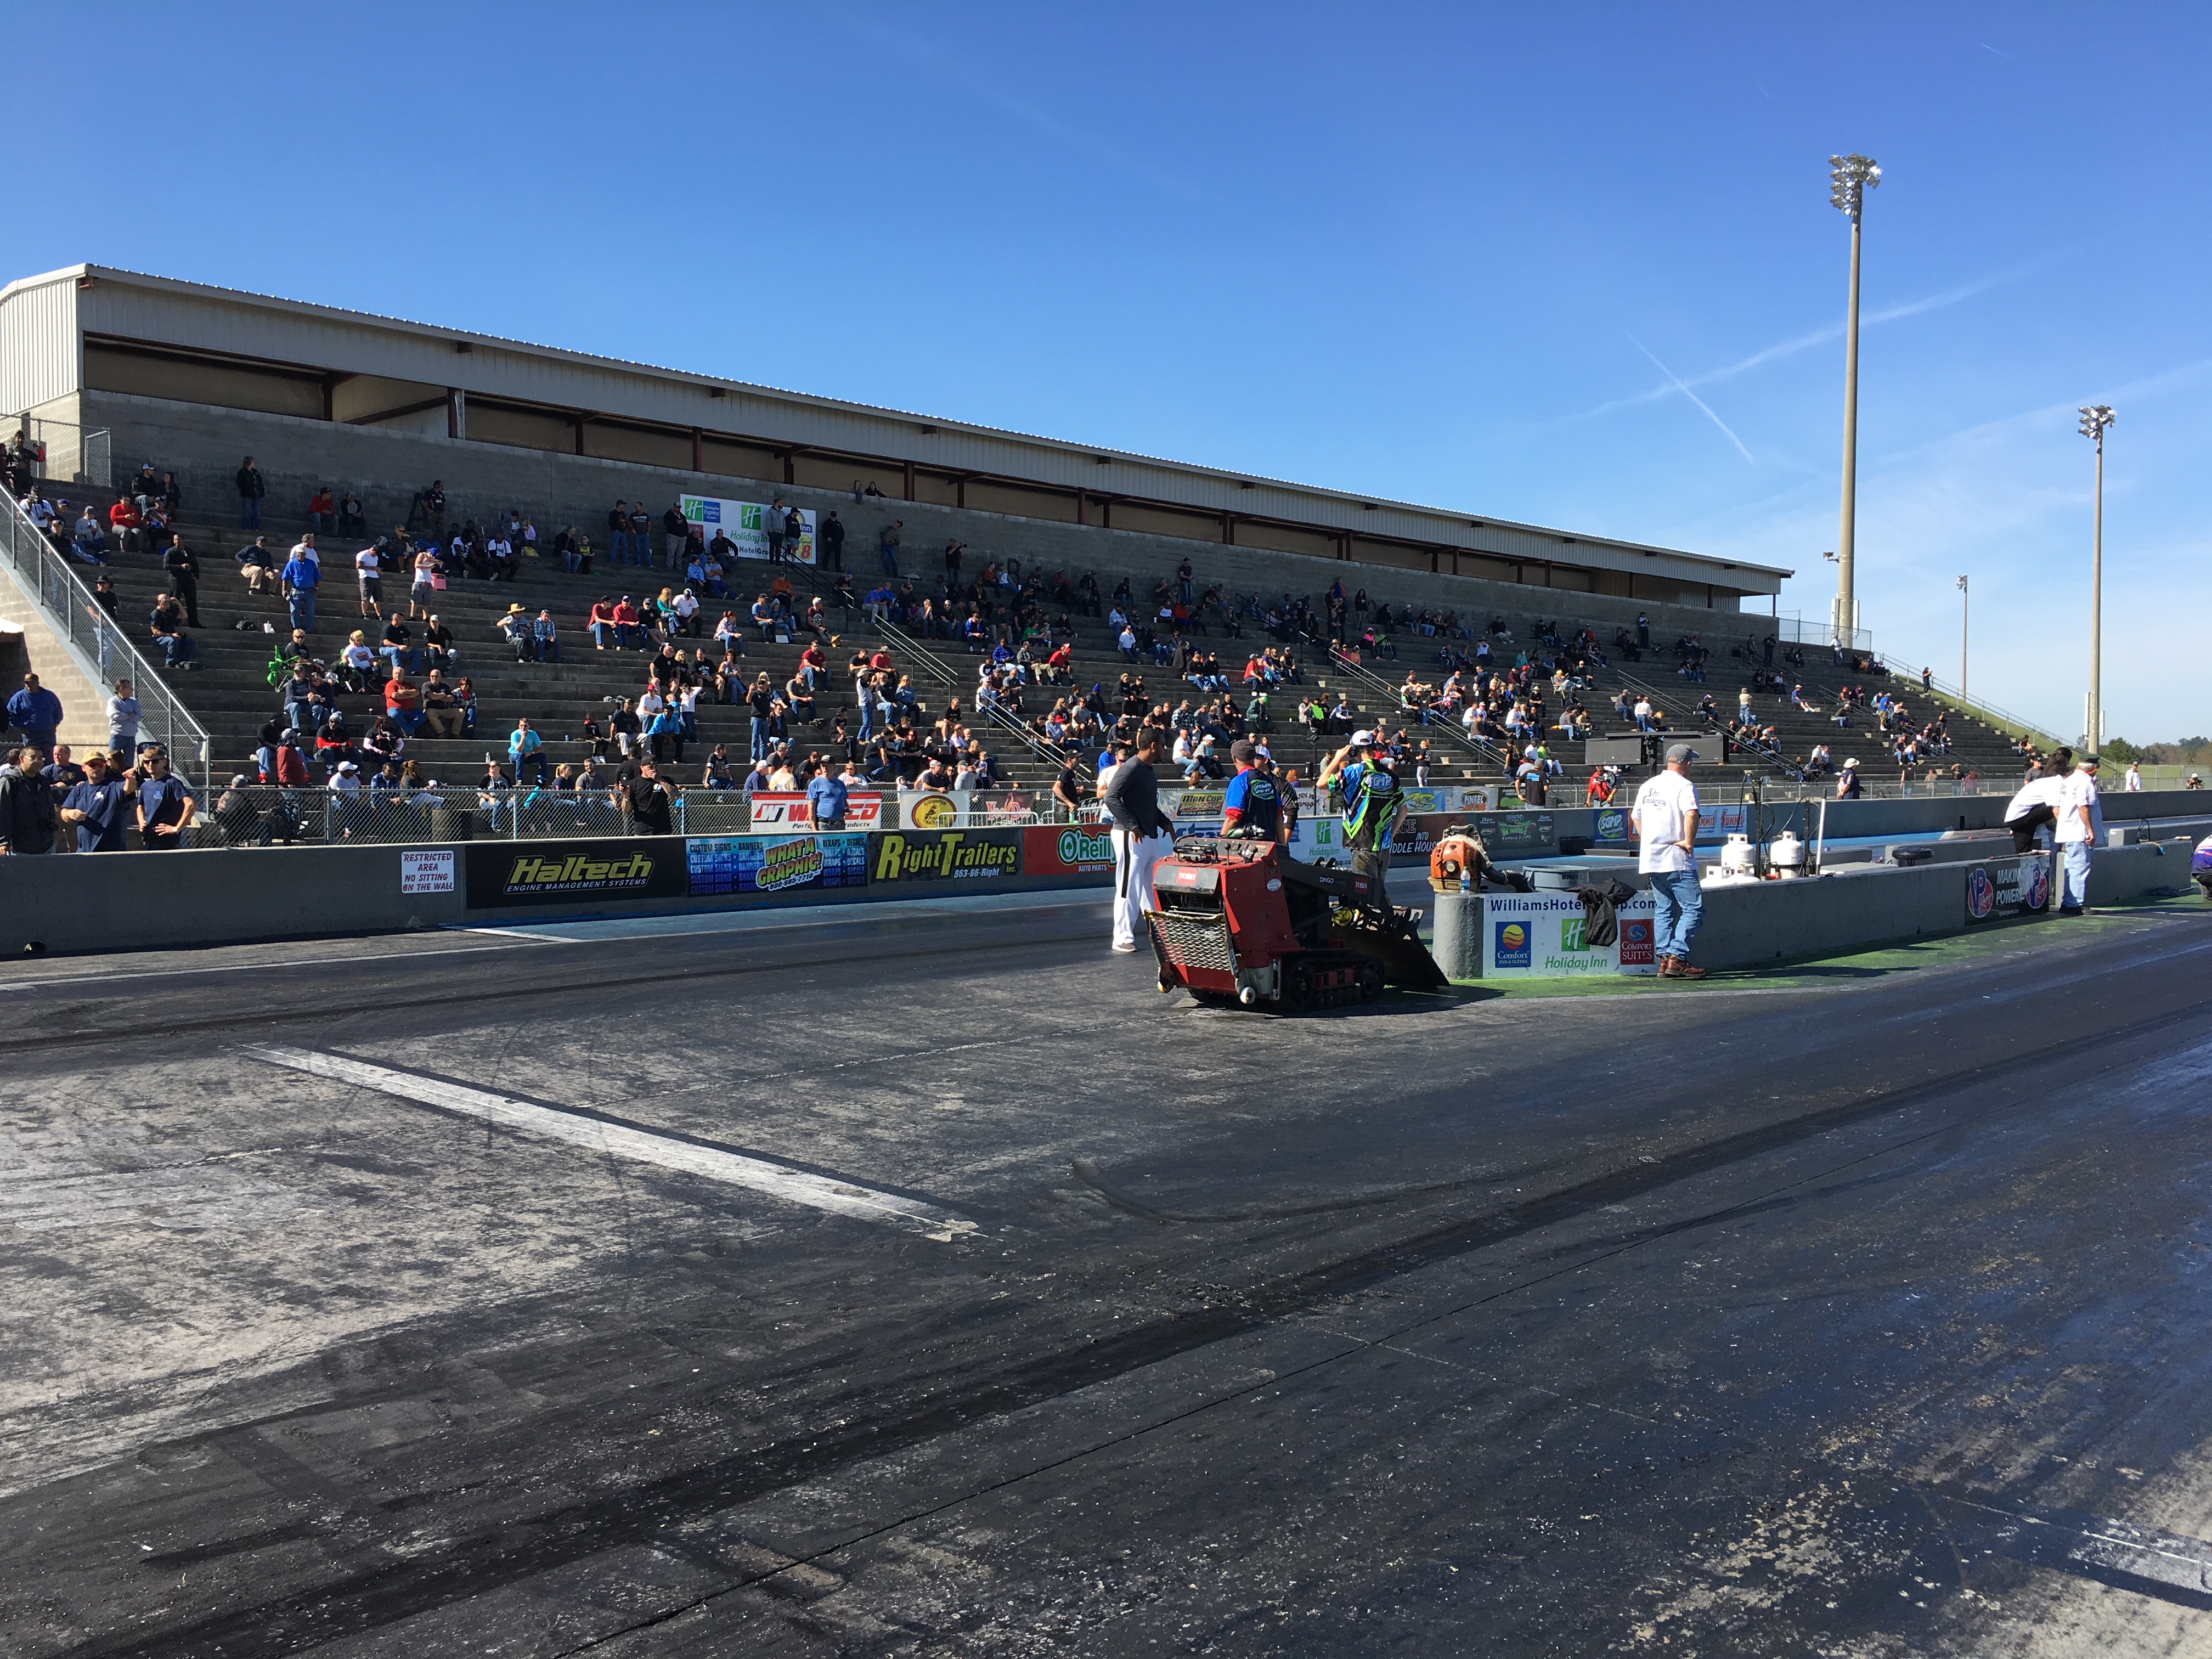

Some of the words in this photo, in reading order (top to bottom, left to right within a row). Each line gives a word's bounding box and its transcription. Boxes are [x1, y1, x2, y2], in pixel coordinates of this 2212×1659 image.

[730, 530, 760, 544] Holiday
[1464, 795, 1484, 804] PINGEL
[1601, 814, 1622, 829] SGMP
[1416, 832, 1429, 840] INTO
[690, 844, 713, 853] CUSTOM
[714, 843, 731, 851] SIGNS
[738, 842, 764, 851] BANNERS
[823, 839, 841, 848] WRAPS
[847, 838, 864, 847] DECALS
[1414, 841, 1437, 853] HOUS
[765, 839, 806, 865] WHAT
[805, 837, 816, 855] A
[823, 848, 841, 857] WRAPS
[1309, 847, 1330, 857] Holiday
[1330, 846, 1339, 855] Inn
[404, 853, 452, 862] RESTRICTED
[690, 854, 713, 864] CUSTOM
[714, 853, 731, 862] SIGNS
[738, 851, 764, 861] BANNERS
[823, 858, 841, 867] WRAPS
[847, 857, 865, 866] DECALS
[417, 863, 438, 871] AREA
[510, 854, 652, 884] Haltech
[690, 864, 713, 874] CUSTOM
[715, 863, 732, 872] SIGNS
[824, 867, 841, 876] WRAPS
[848, 866, 865, 875] DECALS
[419, 873, 448, 882] SITTING
[953, 868, 1000, 878] 863-66-Right
[691, 874, 713, 884] CUSTOM
[715, 873, 732, 882] SIGNS
[824, 877, 842, 886] WRAPS
[848, 876, 865, 884] DECALS
[417, 883, 431, 891] THE
[545, 881, 606, 890] MANAGEMENT
[608, 878, 647, 887] SYSTEMS
[691, 884, 714, 894] CUSTOM
[715, 883, 732, 893] SIGNS
[1498, 950, 1528, 959] Comfort
[1622, 951, 1652, 960] SUITES
[1545, 955, 1588, 971] Holiday
[1590, 955, 1607, 968] Inn
